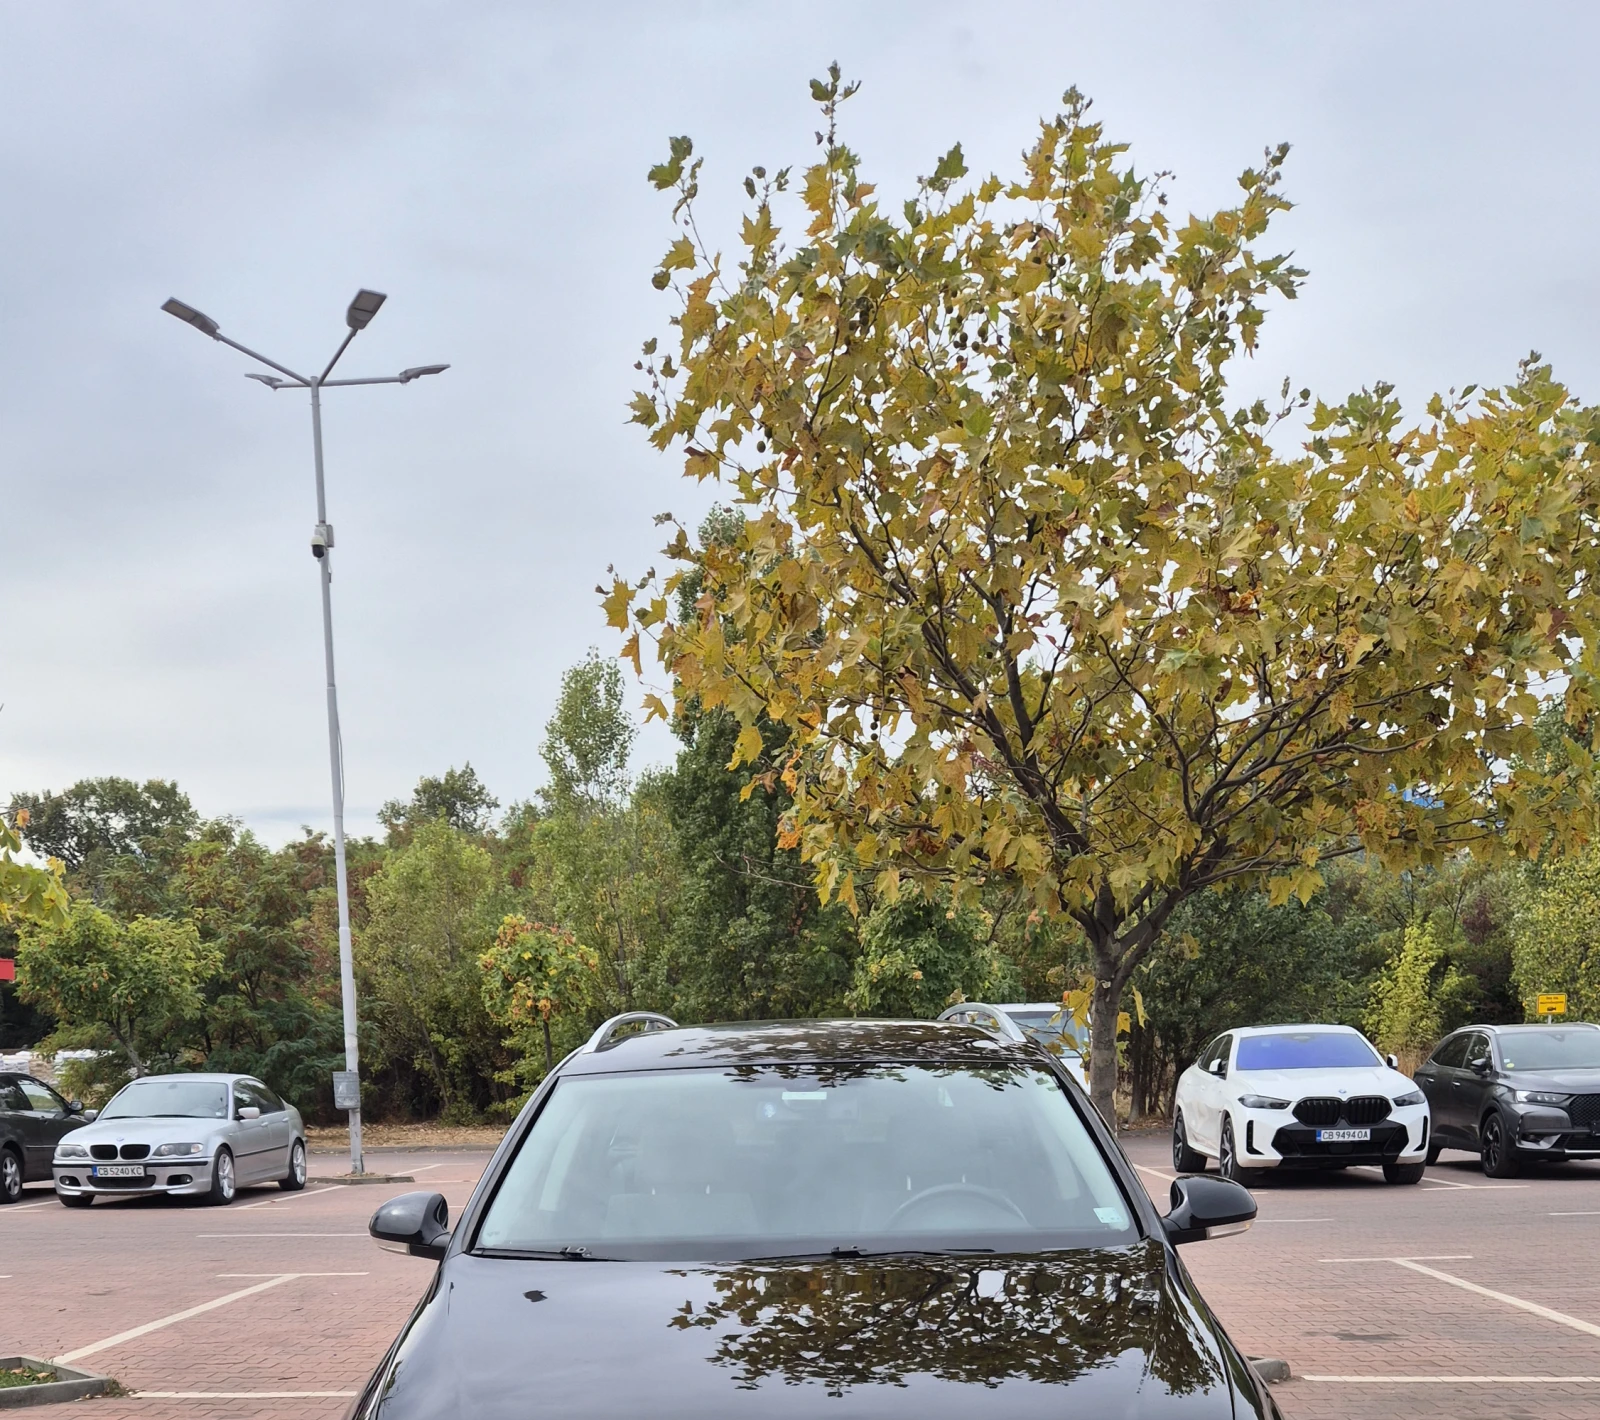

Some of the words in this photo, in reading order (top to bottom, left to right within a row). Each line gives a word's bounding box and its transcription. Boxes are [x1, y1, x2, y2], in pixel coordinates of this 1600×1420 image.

[1322, 1131, 1334, 1140] CB
[1335, 1130, 1356, 1139] 9494
[98, 1167, 109, 1176] CB
[110, 1167, 130, 1176] 5240
[131, 1166, 143, 1175] KC
